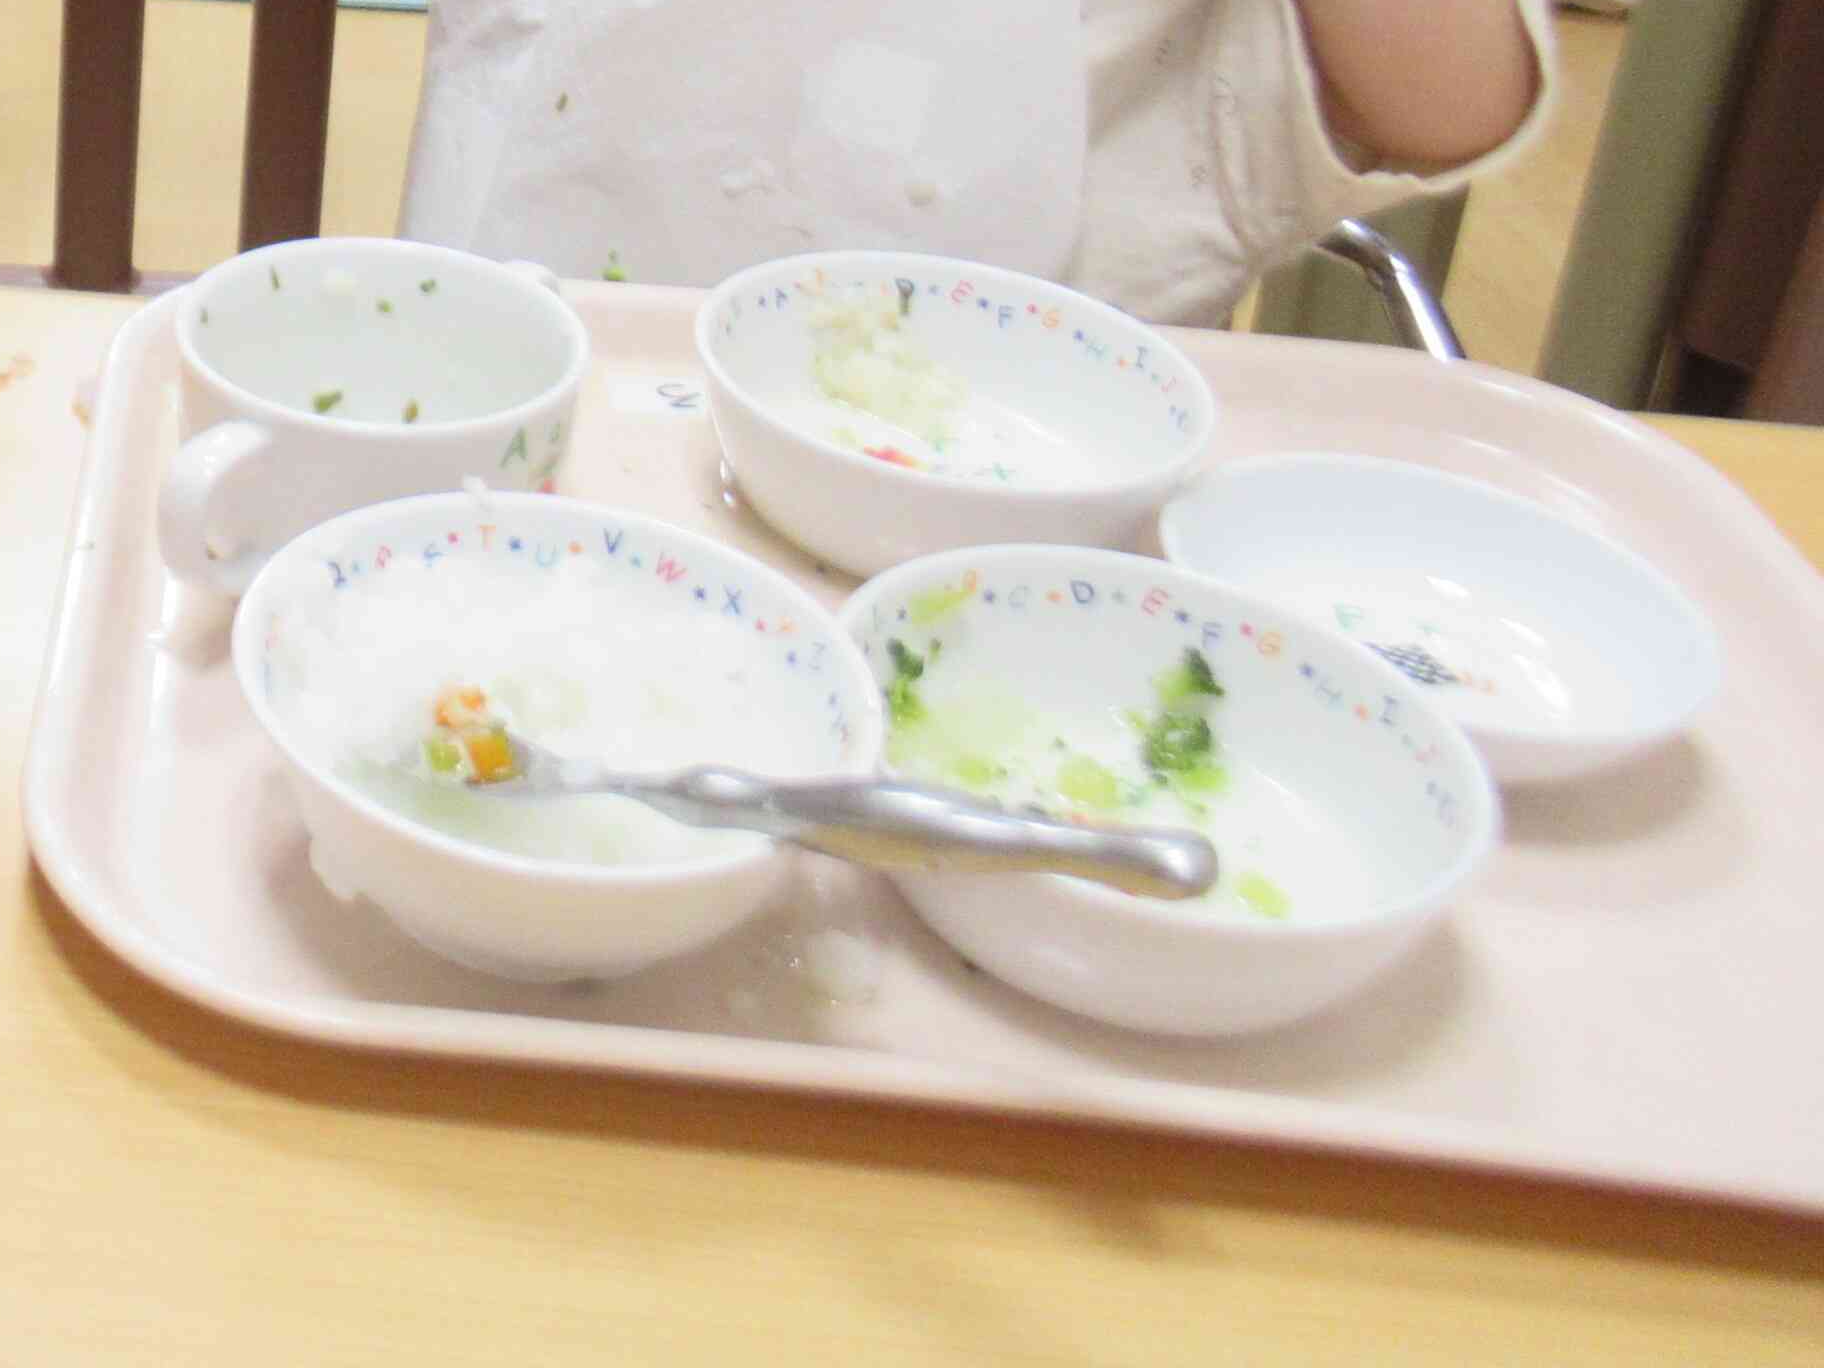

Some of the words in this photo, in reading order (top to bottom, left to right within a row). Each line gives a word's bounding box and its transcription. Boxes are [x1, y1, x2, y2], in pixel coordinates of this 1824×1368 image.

[998, 304, 1016, 329] F
[499, 424, 529, 468] A
[480, 524, 497, 552] T
[534, 542, 558, 568] U
[603, 526, 624, 555] V
[655, 546, 688, 584] W
[721, 583, 743, 616] X
[1069, 580, 1095, 605] D
[1141, 587, 1170, 617] E
[1201, 620, 1223, 649] F
